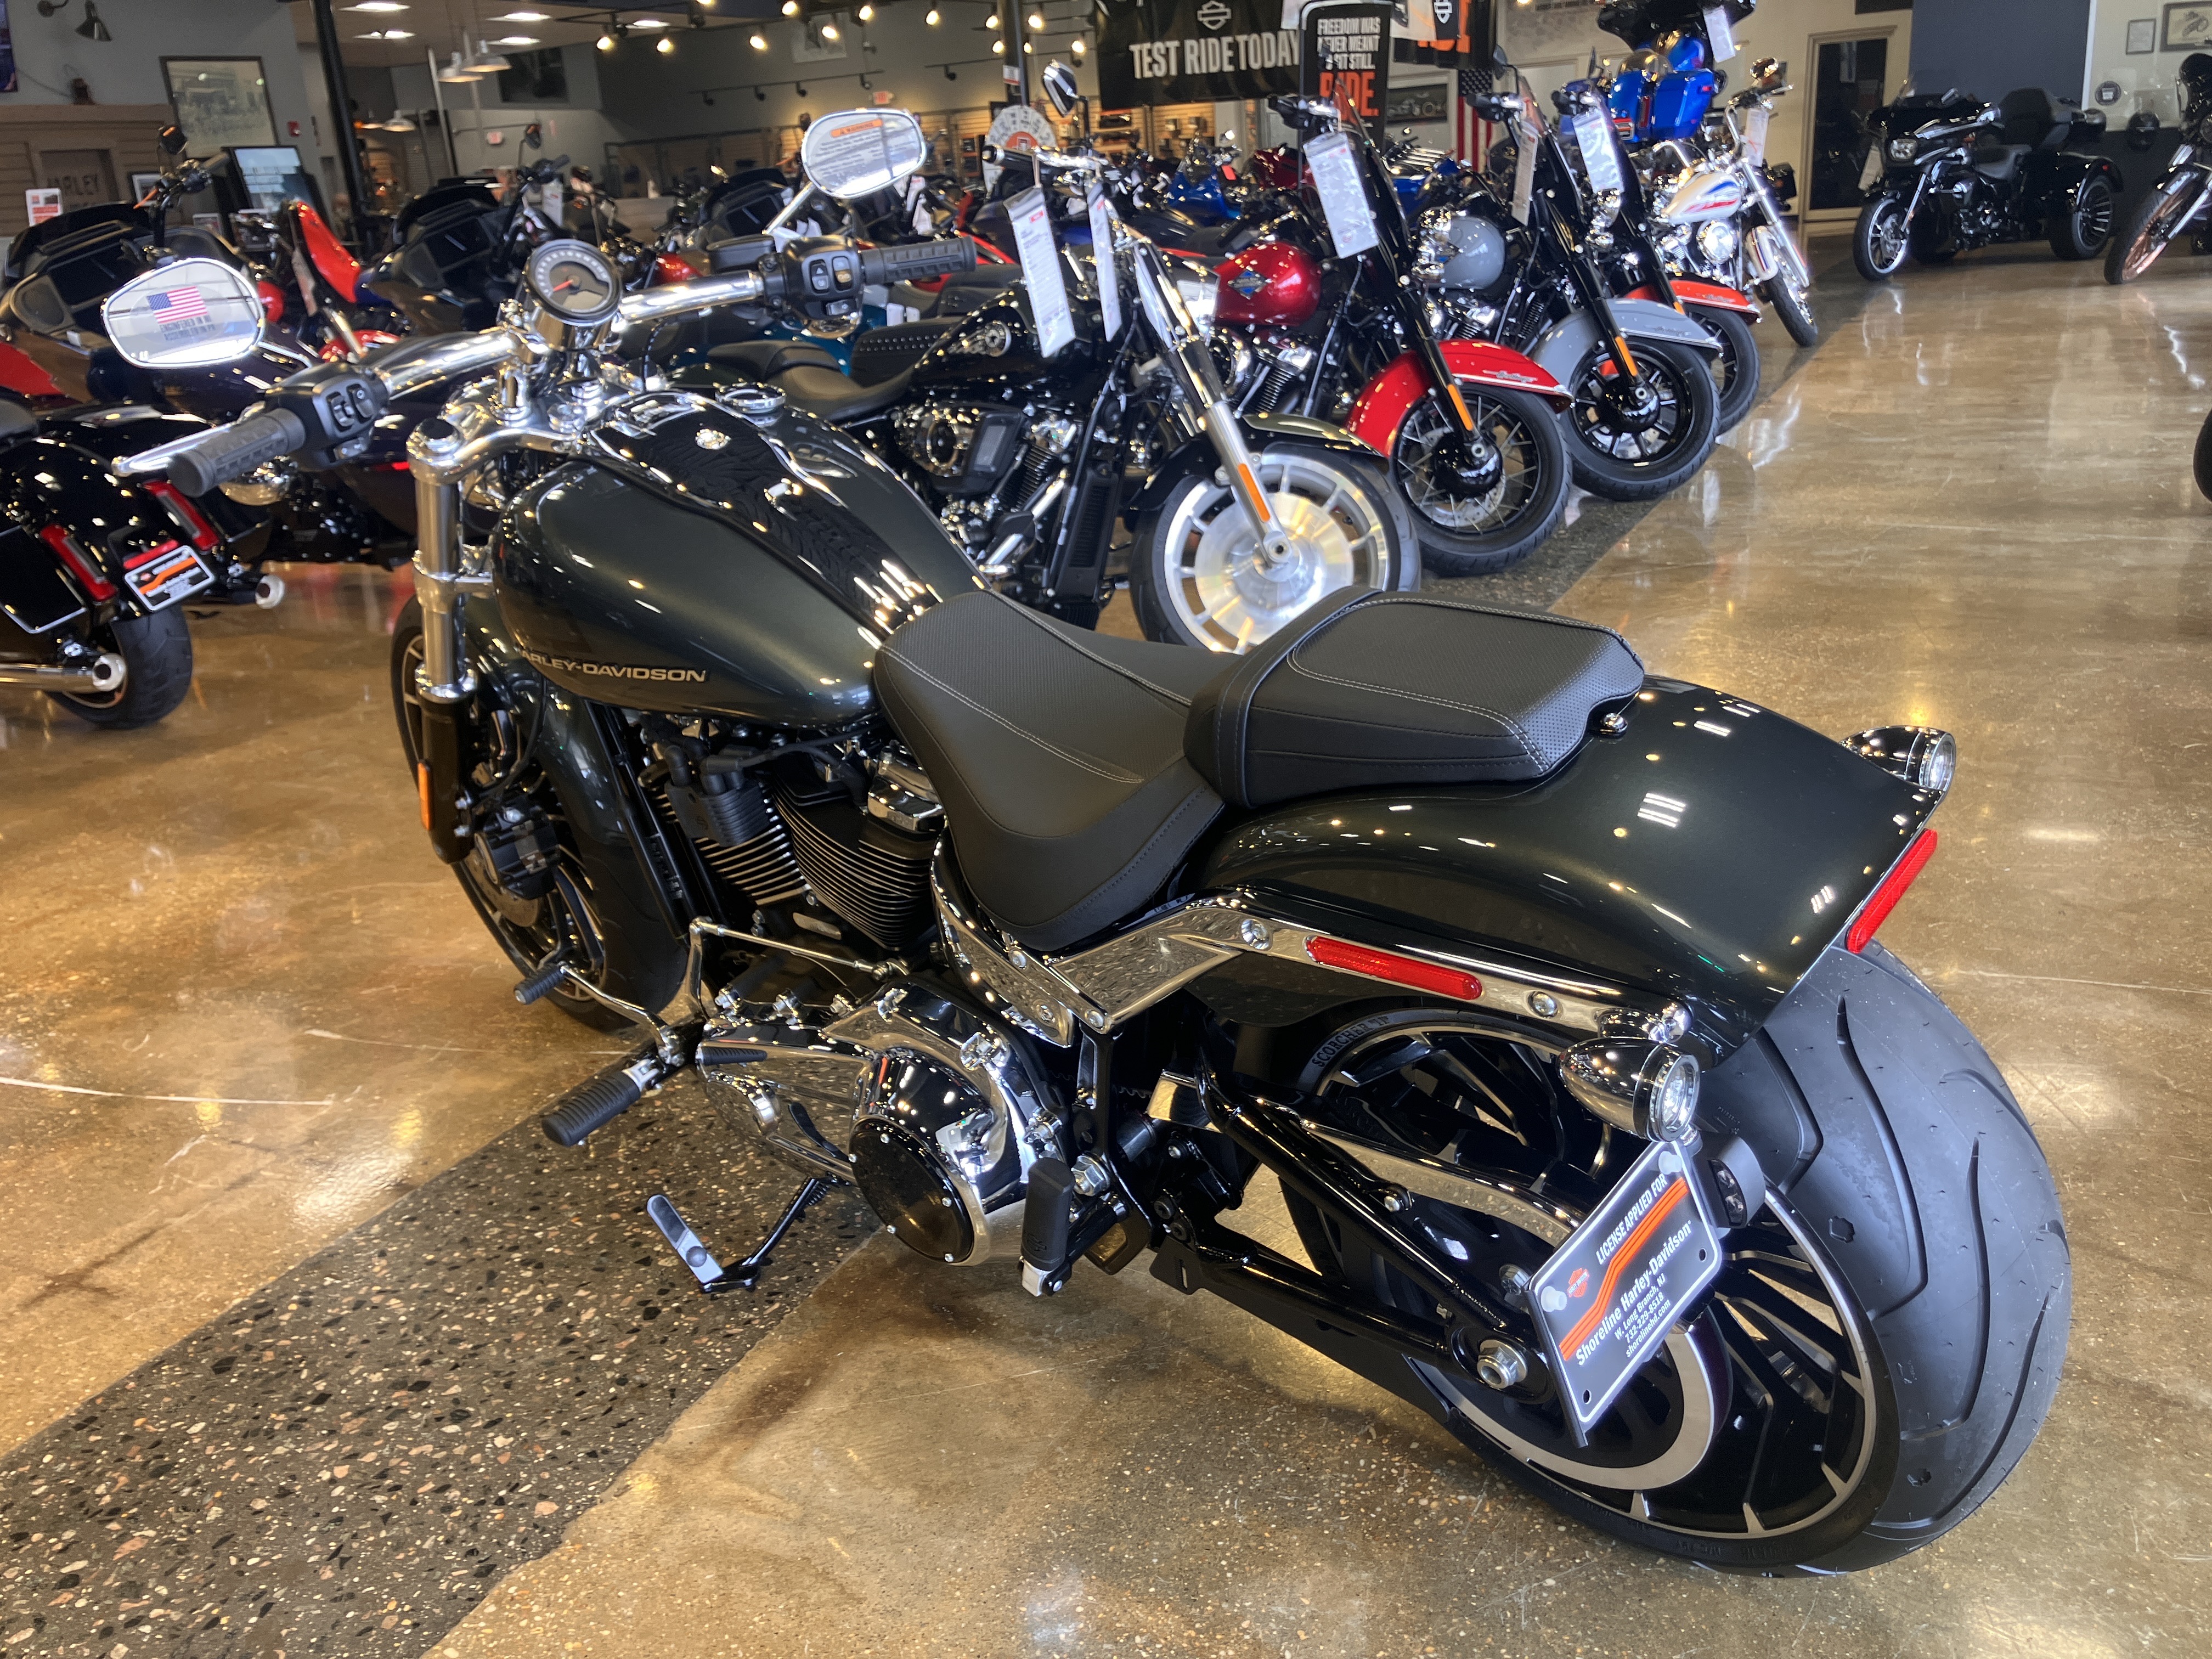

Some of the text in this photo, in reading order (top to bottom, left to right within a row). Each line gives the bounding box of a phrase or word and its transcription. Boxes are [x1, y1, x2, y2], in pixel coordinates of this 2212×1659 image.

[1129, 30, 1300, 79] TEST RIDE TODAY
[521, 650, 706, 682] ARLEY-DAVIDSON
[1312, 1023, 1374, 1067] SCORCHER
[1596, 1173, 1668, 1265] LICENSE APPLIED FOR
[1576, 1220, 1692, 1365] Shoreline Harley-Davidson
[1614, 1272, 1666, 1340] W. Long Branch, NJ
[1624, 1291, 1664, 1344] 732-229-8518
[1626, 1299, 1671, 1358] shorelinehd.com
